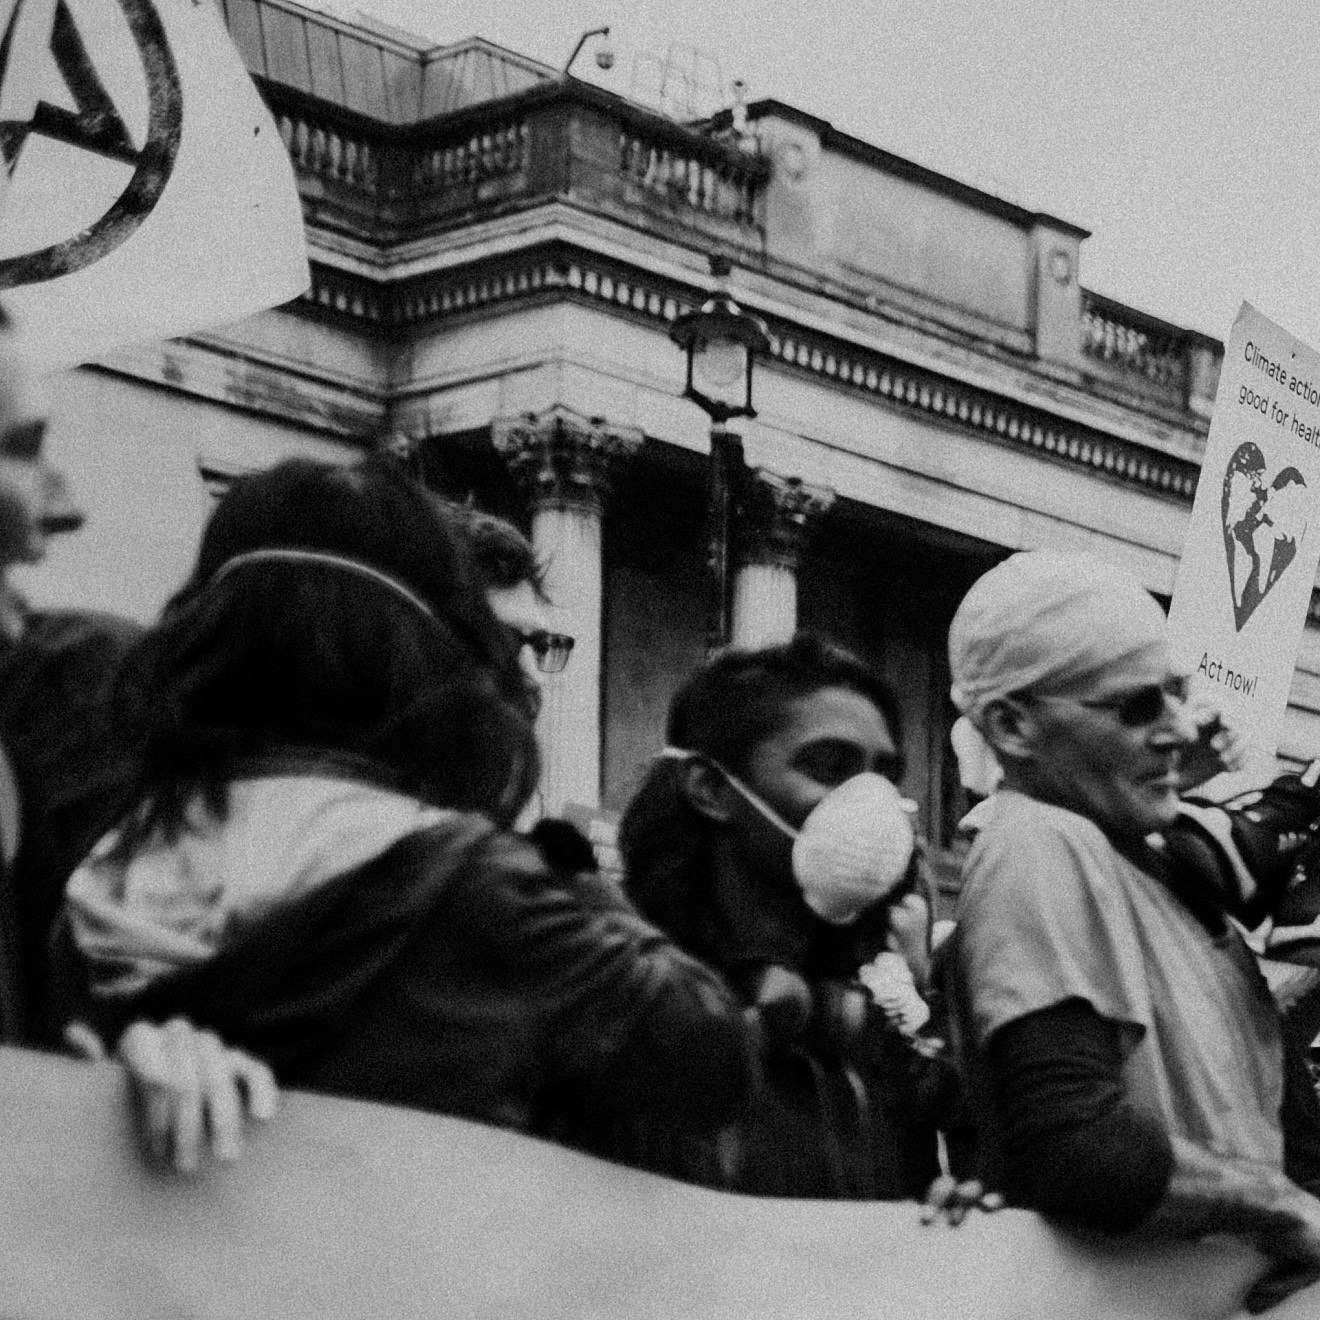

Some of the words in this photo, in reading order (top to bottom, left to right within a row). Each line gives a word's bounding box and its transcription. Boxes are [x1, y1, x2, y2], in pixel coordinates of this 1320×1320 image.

[1244, 341, 1286, 386] Climate
[1238, 385, 1268, 416] good
[1271, 400, 1288, 427] for
[1198, 652, 1223, 685] Act
[1225, 667, 1259, 699] now!
